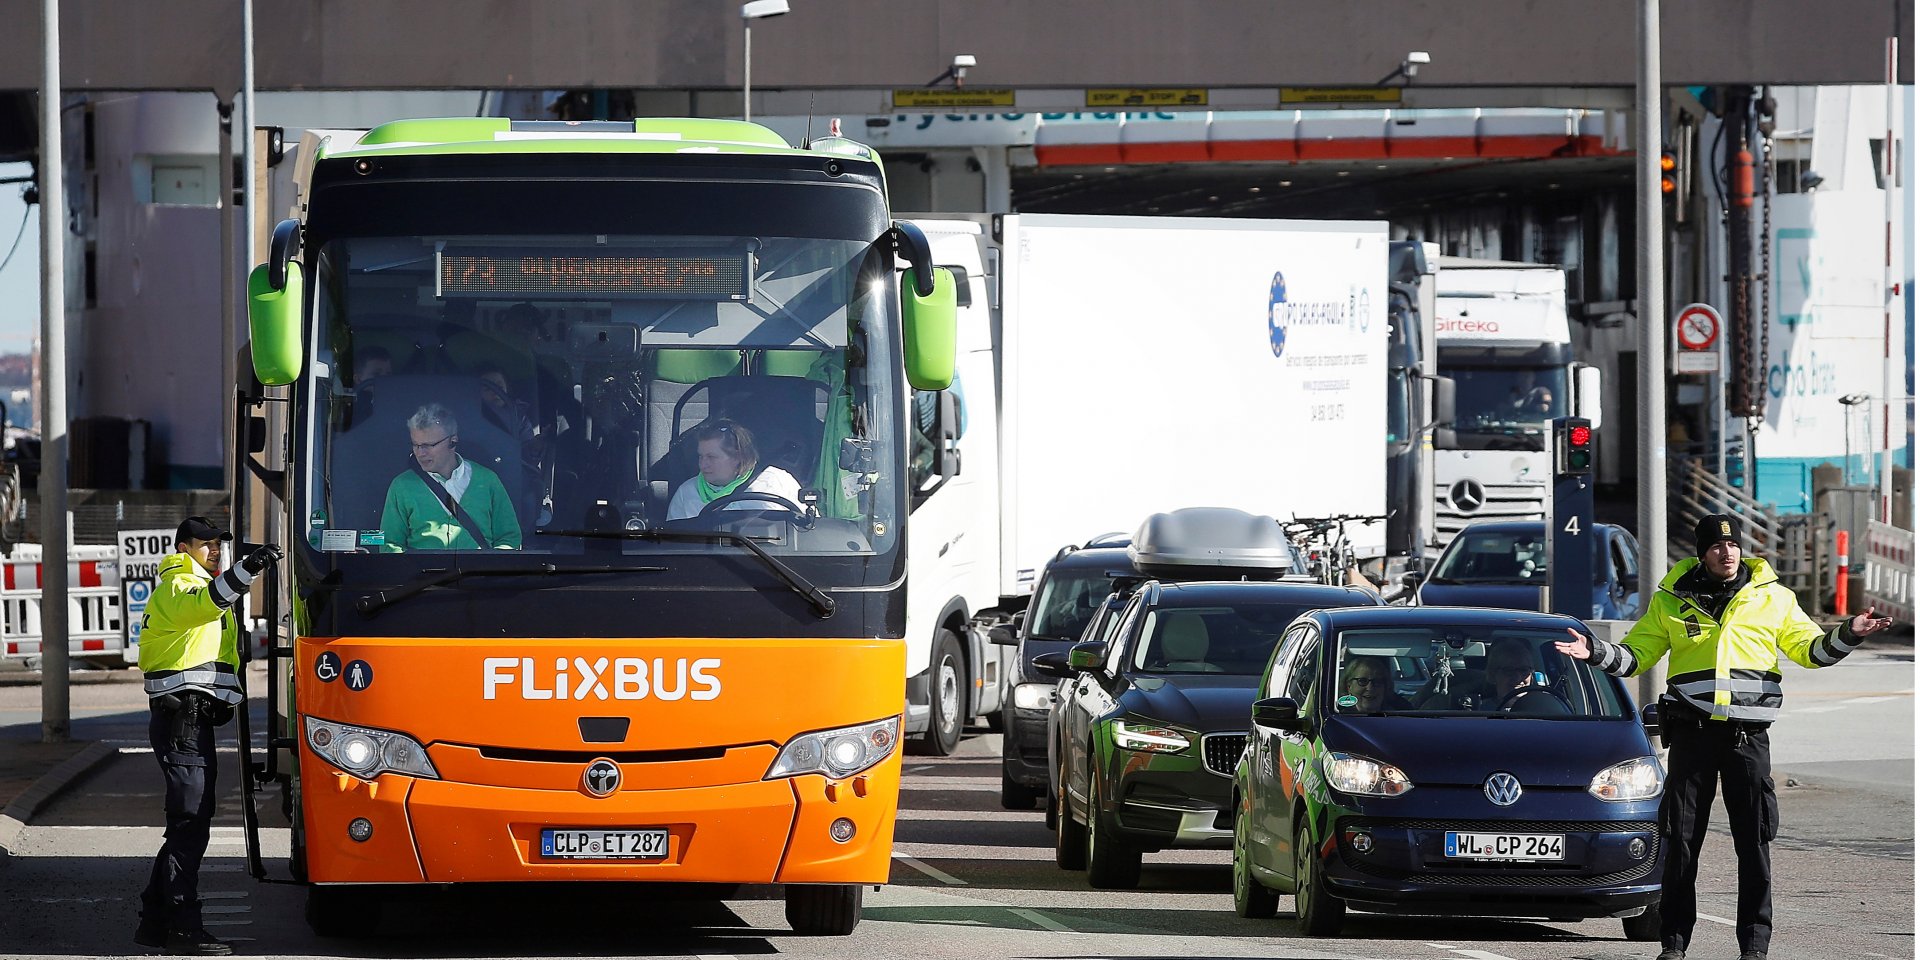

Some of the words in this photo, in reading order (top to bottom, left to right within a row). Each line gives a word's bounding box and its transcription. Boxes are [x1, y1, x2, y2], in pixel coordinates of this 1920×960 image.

[1435, 316, 1499, 333] Girteka
[1564, 515, 1581, 536] 4
[124, 535, 172, 556] STOP
[125, 562, 161, 578] BYGG
[554, 833, 589, 853] CLP
[603, 833, 627, 853] ET
[631, 833, 665, 853] 287
[1457, 834, 1482, 854] WL
[1496, 836, 1522, 855] CP
[1525, 837, 1562, 856] 264
